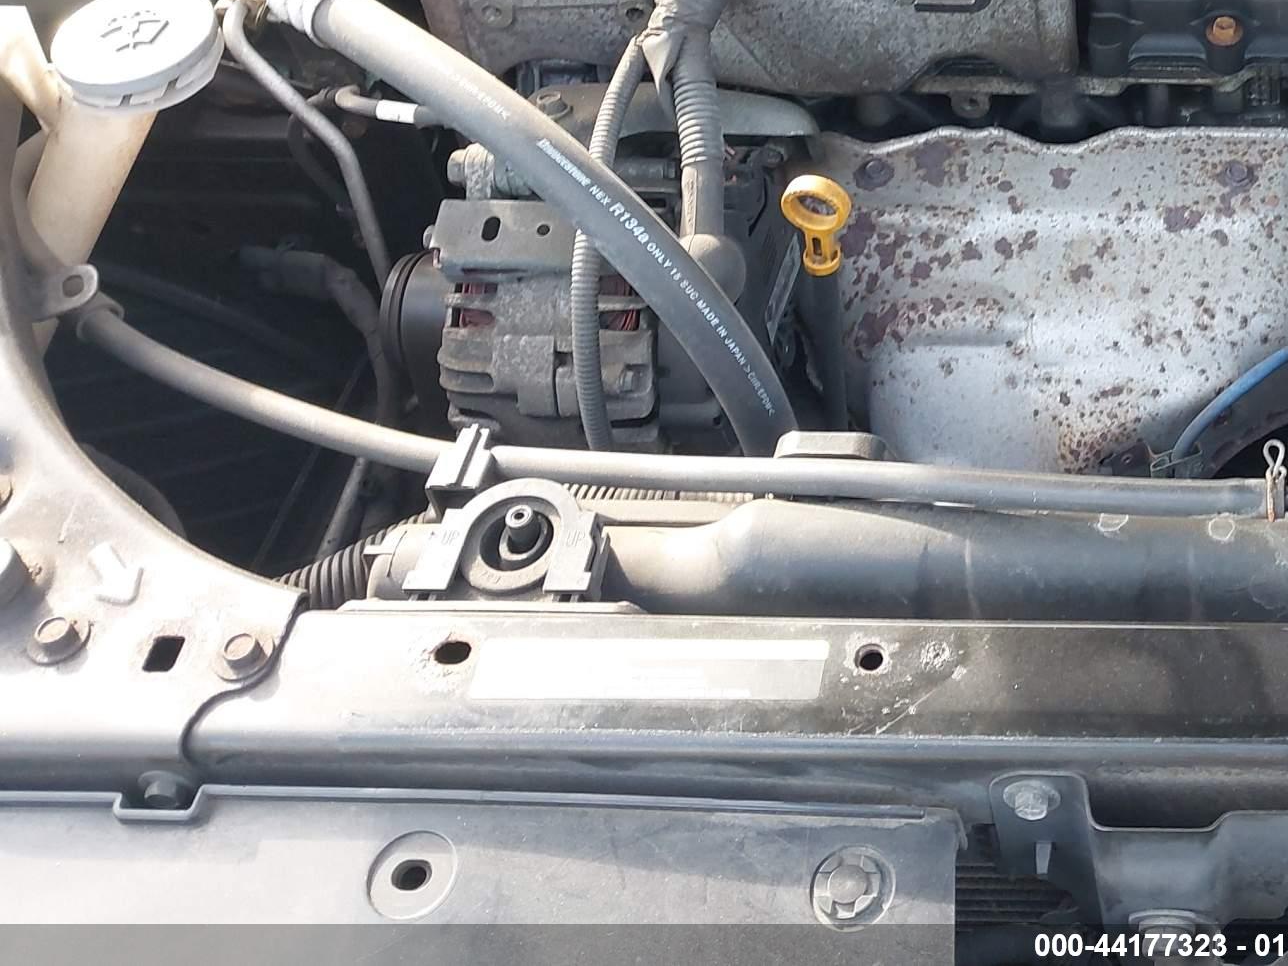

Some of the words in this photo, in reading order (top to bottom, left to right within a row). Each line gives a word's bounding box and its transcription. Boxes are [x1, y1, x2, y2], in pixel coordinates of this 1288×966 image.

[588, 184, 611, 206] NEX
[608, 201, 649, 245] R134a
[646, 240, 673, 268] ONLY
[696, 298, 719, 327] MADE
[715, 325, 728, 339] IN
[724, 337, 747, 366] JAPAN
